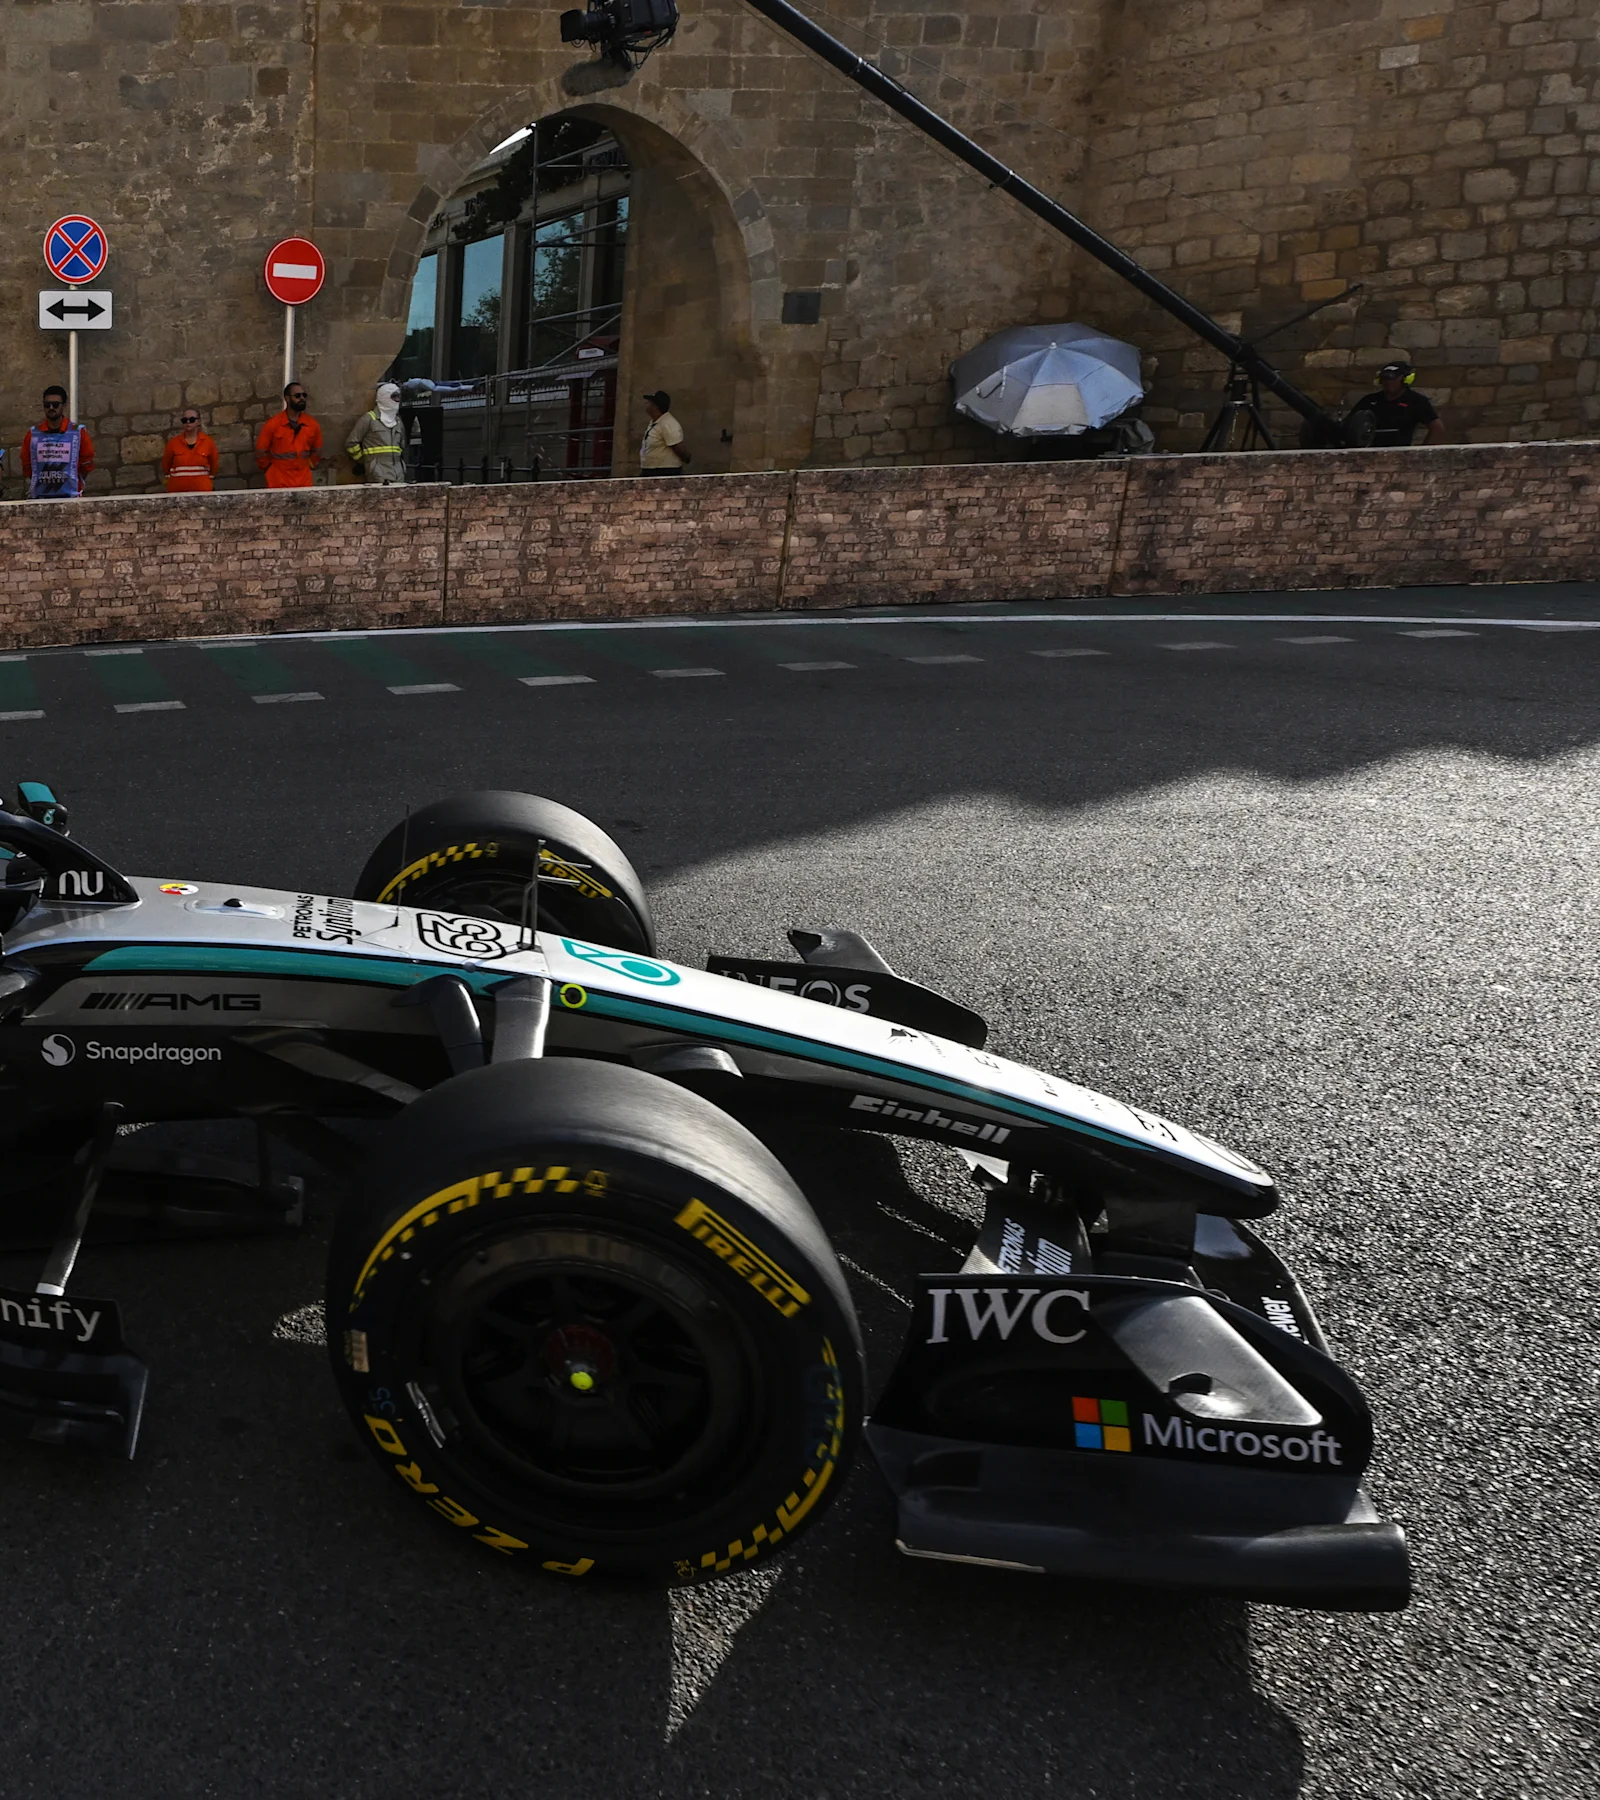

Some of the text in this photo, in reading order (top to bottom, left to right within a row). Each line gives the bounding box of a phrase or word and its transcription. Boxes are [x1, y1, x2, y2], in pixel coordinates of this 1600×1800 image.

[59, 871, 104, 895] nu
[292, 894, 314, 939] PETRONAS
[316, 898, 362, 945] Syntium
[416, 912, 508, 960] 63
[138, 993, 261, 1011] AMG
[720, 969, 872, 1014] EOS
[86, 1041, 222, 1065] Snapdragon
[849, 1094, 1012, 1144] Einhell
[673, 1197, 811, 1319] PIRELLI
[997, 1217, 1026, 1274] ETRONAS
[1024, 1237, 1073, 1275] tium
[926, 1288, 1090, 1344] IWC
[1142, 1412, 1343, 1466] Microsoft
[364, 1415, 595, 1577] P ZERO
